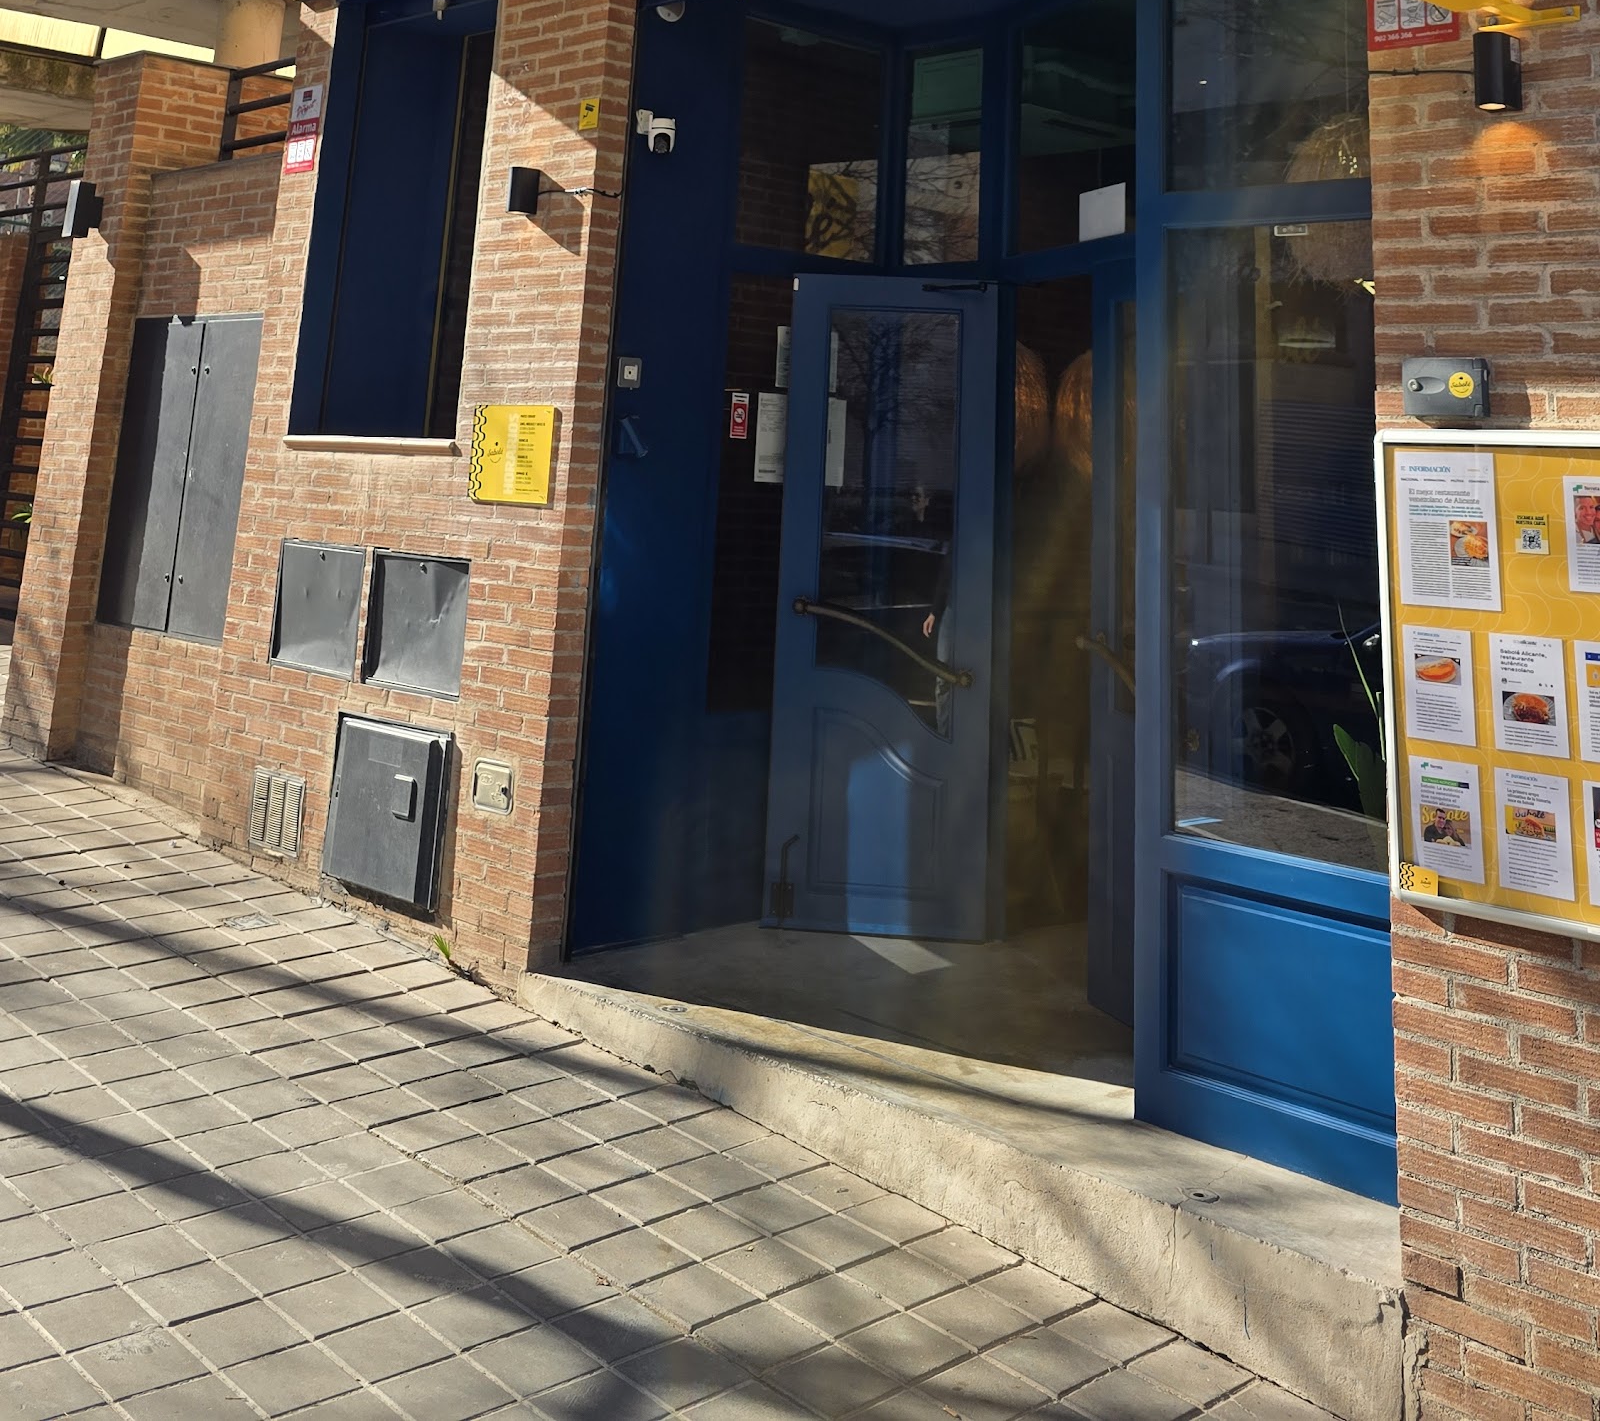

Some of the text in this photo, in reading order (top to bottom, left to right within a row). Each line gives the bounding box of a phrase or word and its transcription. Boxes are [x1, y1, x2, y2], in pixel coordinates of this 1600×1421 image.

[291, 122, 317, 136] Alarma
[1408, 465, 1451, 473] INFORMACIÓN
[1416, 489, 1434, 497] mejor
[1435, 489, 1471, 497] restaurante
[1453, 497, 1480, 505] Alicante
